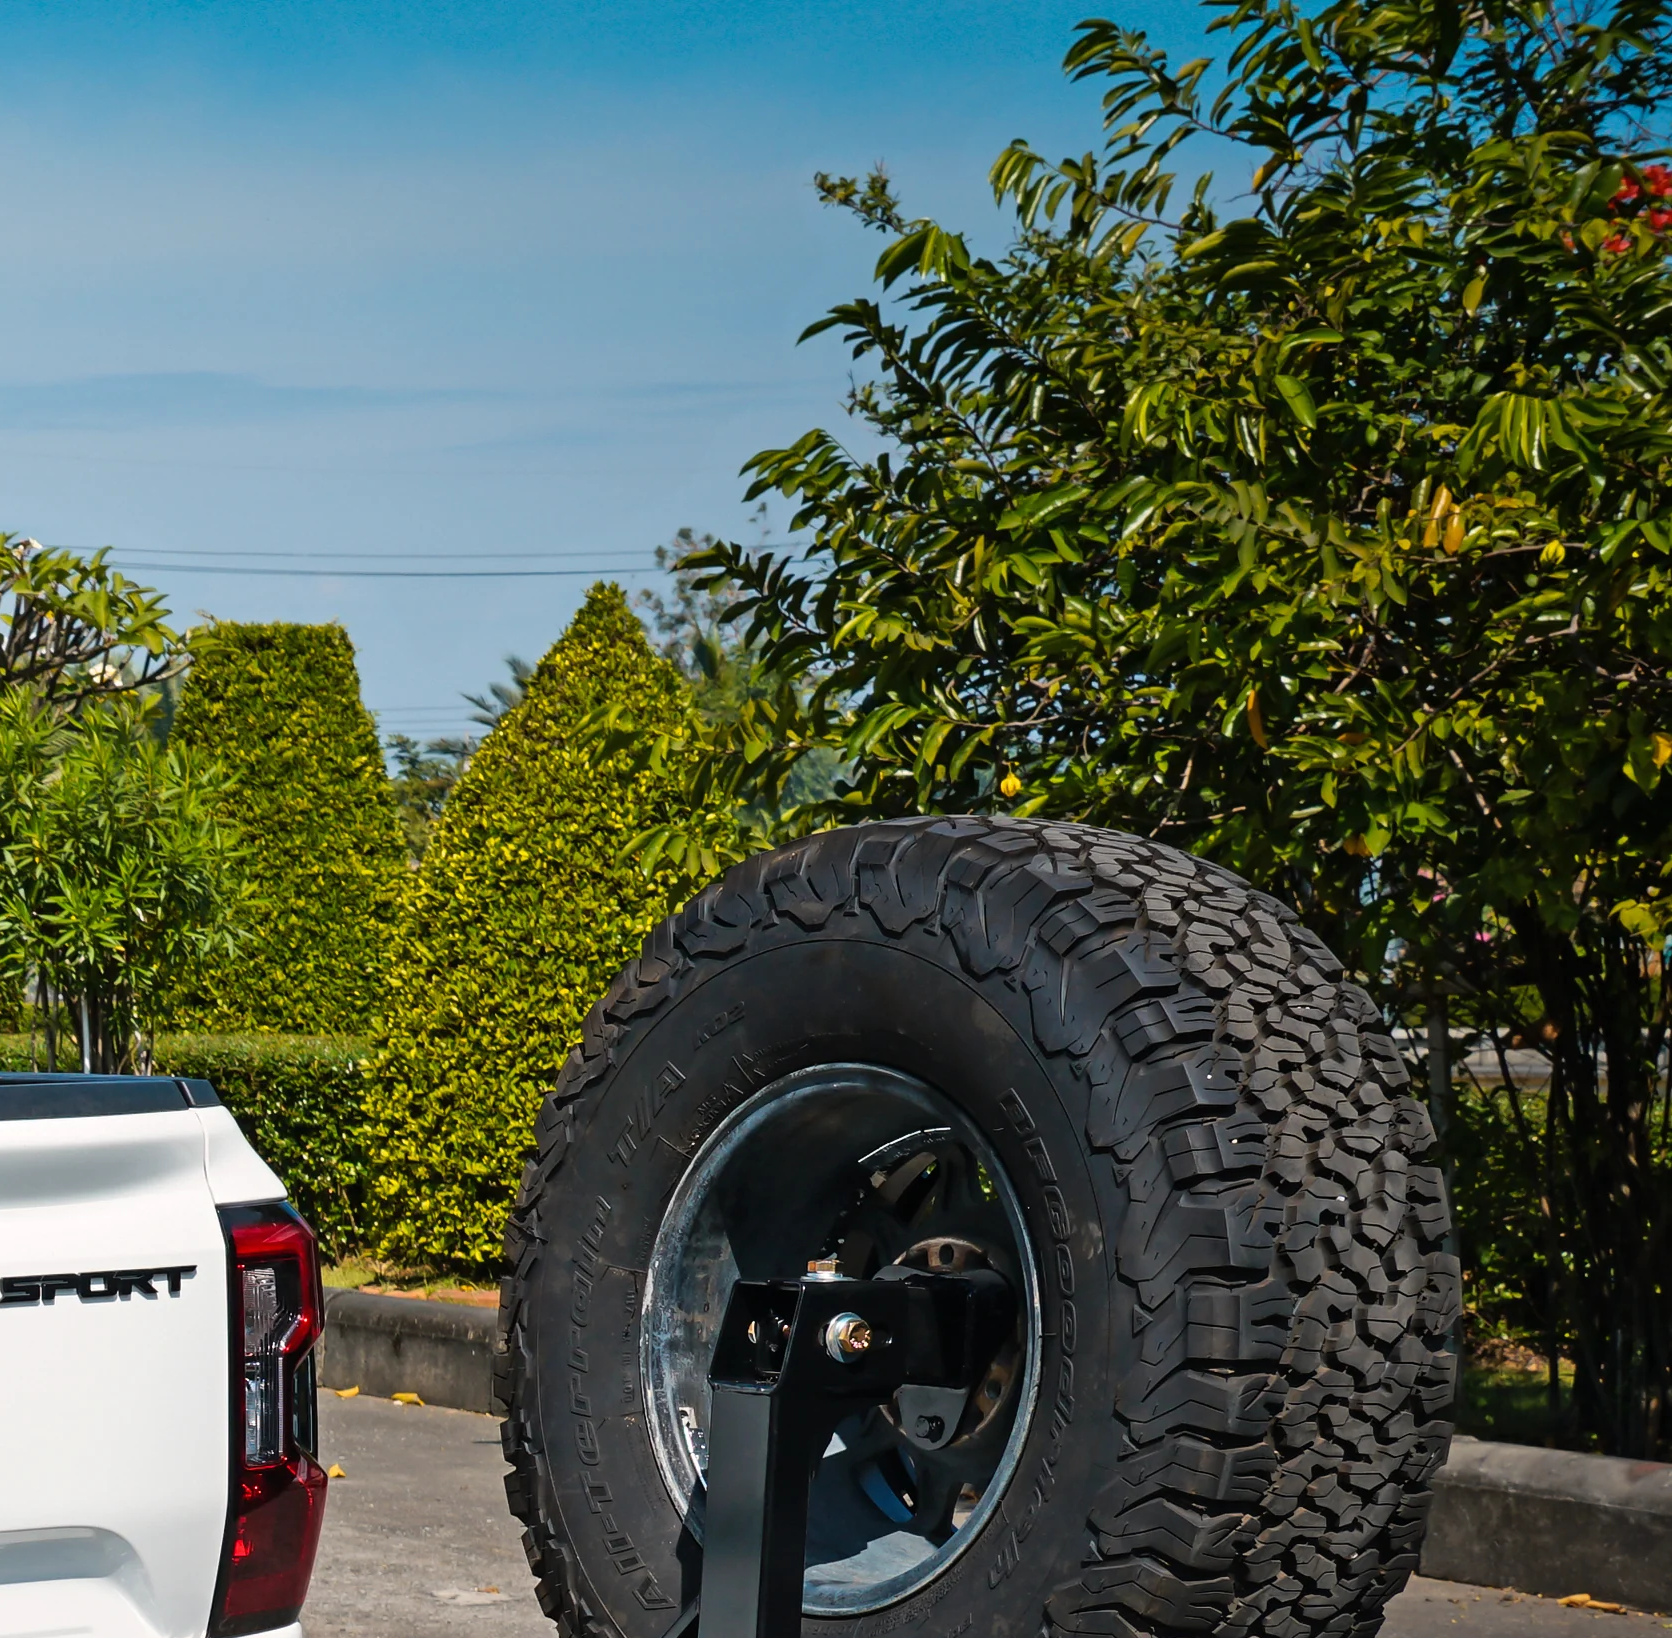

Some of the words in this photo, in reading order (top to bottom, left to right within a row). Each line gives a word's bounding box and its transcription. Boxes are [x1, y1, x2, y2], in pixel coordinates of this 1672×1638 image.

[606, 1060, 687, 1168] T/A
[567, 1195, 678, 1610] All-Terrain
[988, 1087, 1077, 1590] BFGoodrich
